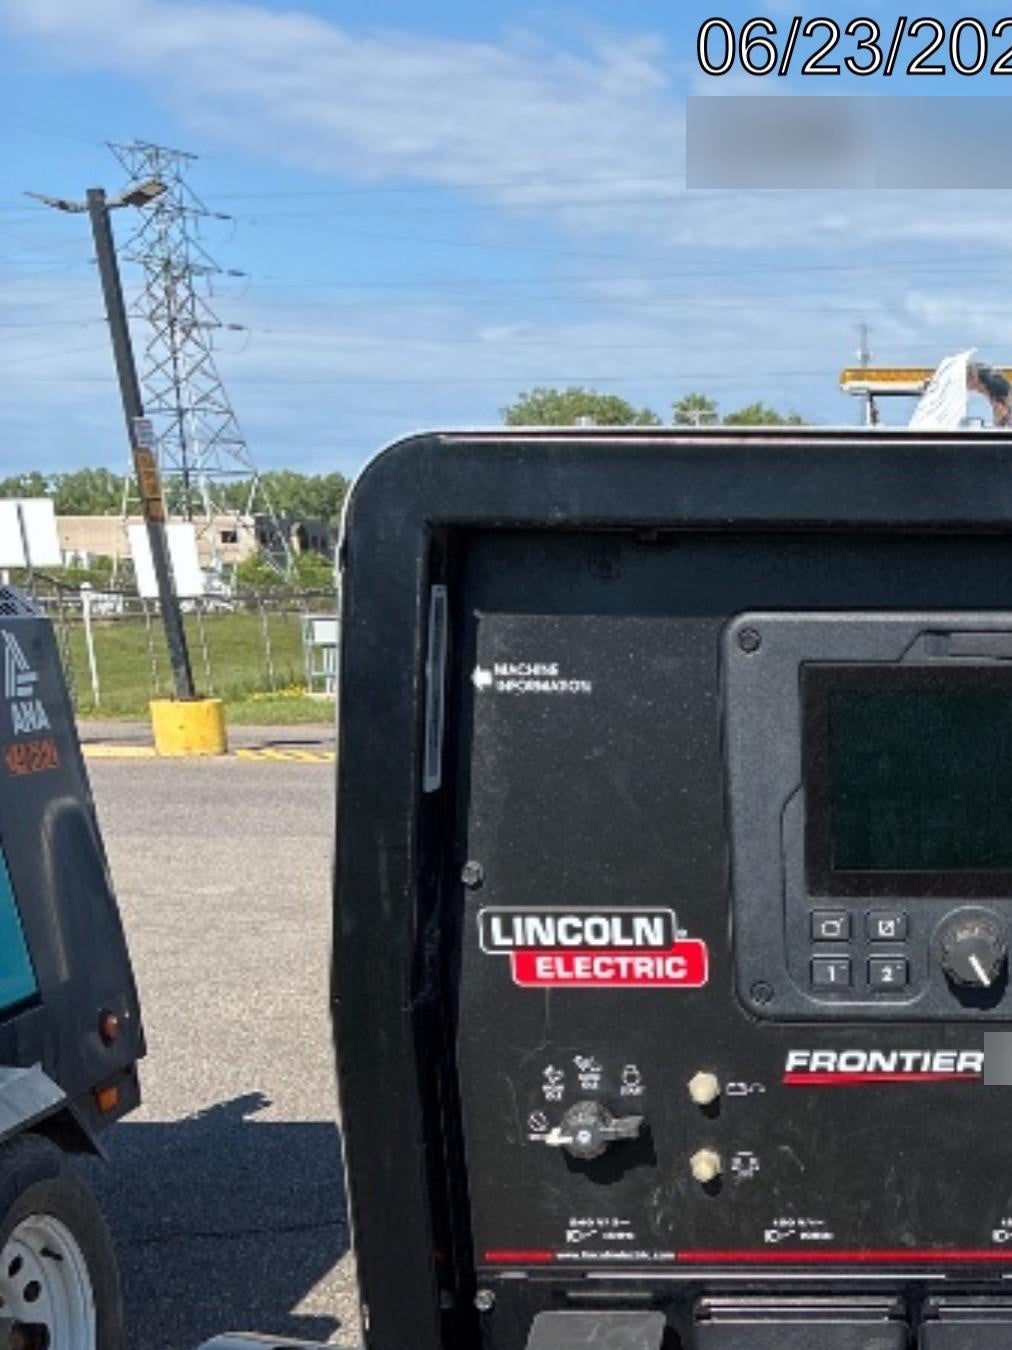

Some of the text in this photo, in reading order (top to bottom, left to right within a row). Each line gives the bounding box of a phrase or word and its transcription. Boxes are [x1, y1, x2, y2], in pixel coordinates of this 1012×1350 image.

[491, 916, 664, 946] LINCOLN
[535, 956, 688, 979] ELECTRIC
[827, 965, 837, 982] 1
[880, 965, 894, 982] 2
[785, 1050, 985, 1072] FRONTIER
